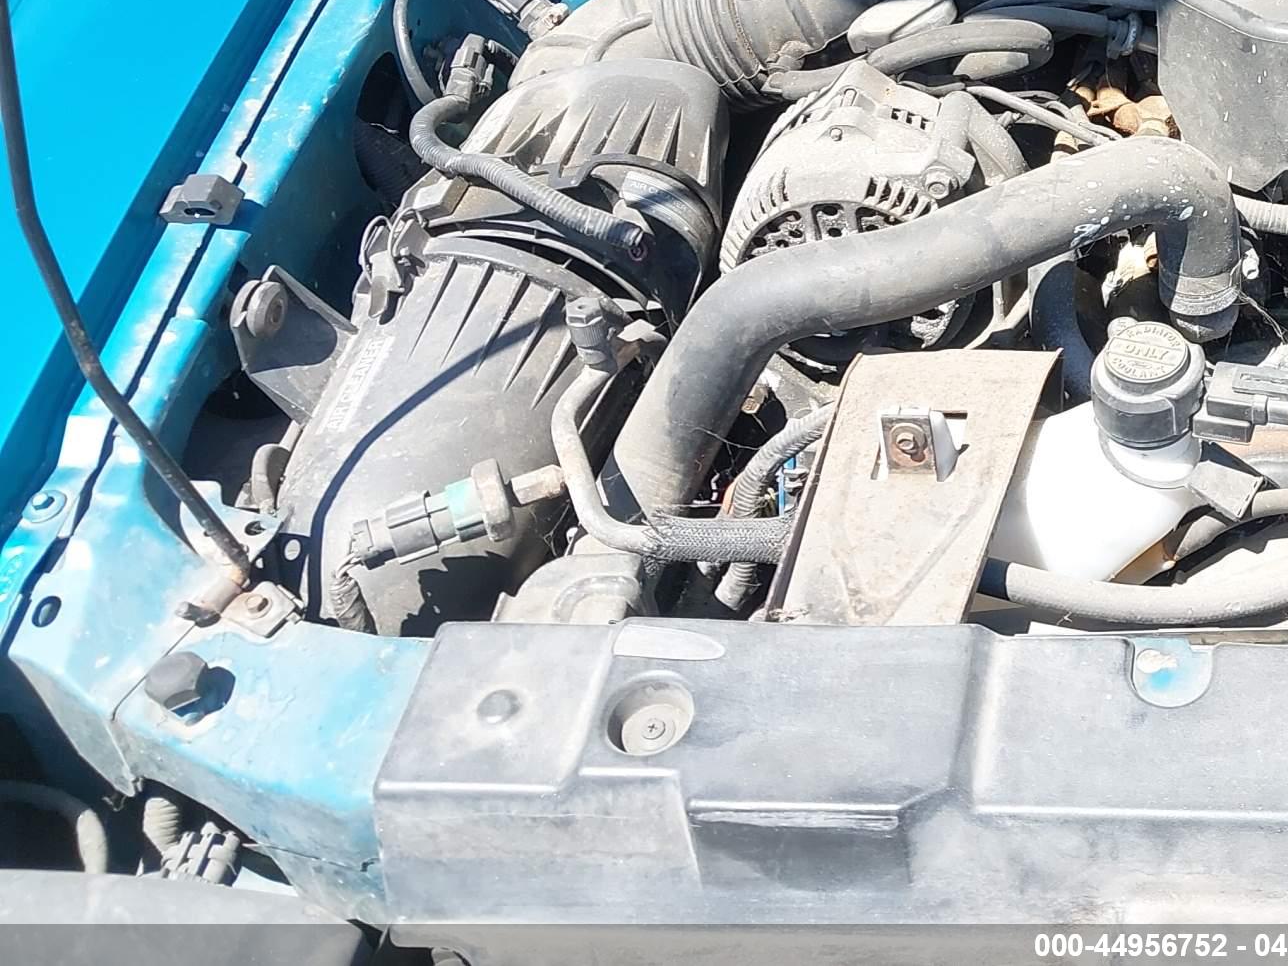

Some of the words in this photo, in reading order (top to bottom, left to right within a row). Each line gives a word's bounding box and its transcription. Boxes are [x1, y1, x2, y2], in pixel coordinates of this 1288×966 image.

[629, 180, 648, 192] AIR
[1126, 325, 1181, 347] RADIATOR
[1125, 344, 1169, 361] ONLY
[1112, 357, 1166, 378] COOLANT
[325, 403, 348, 432] AIR
